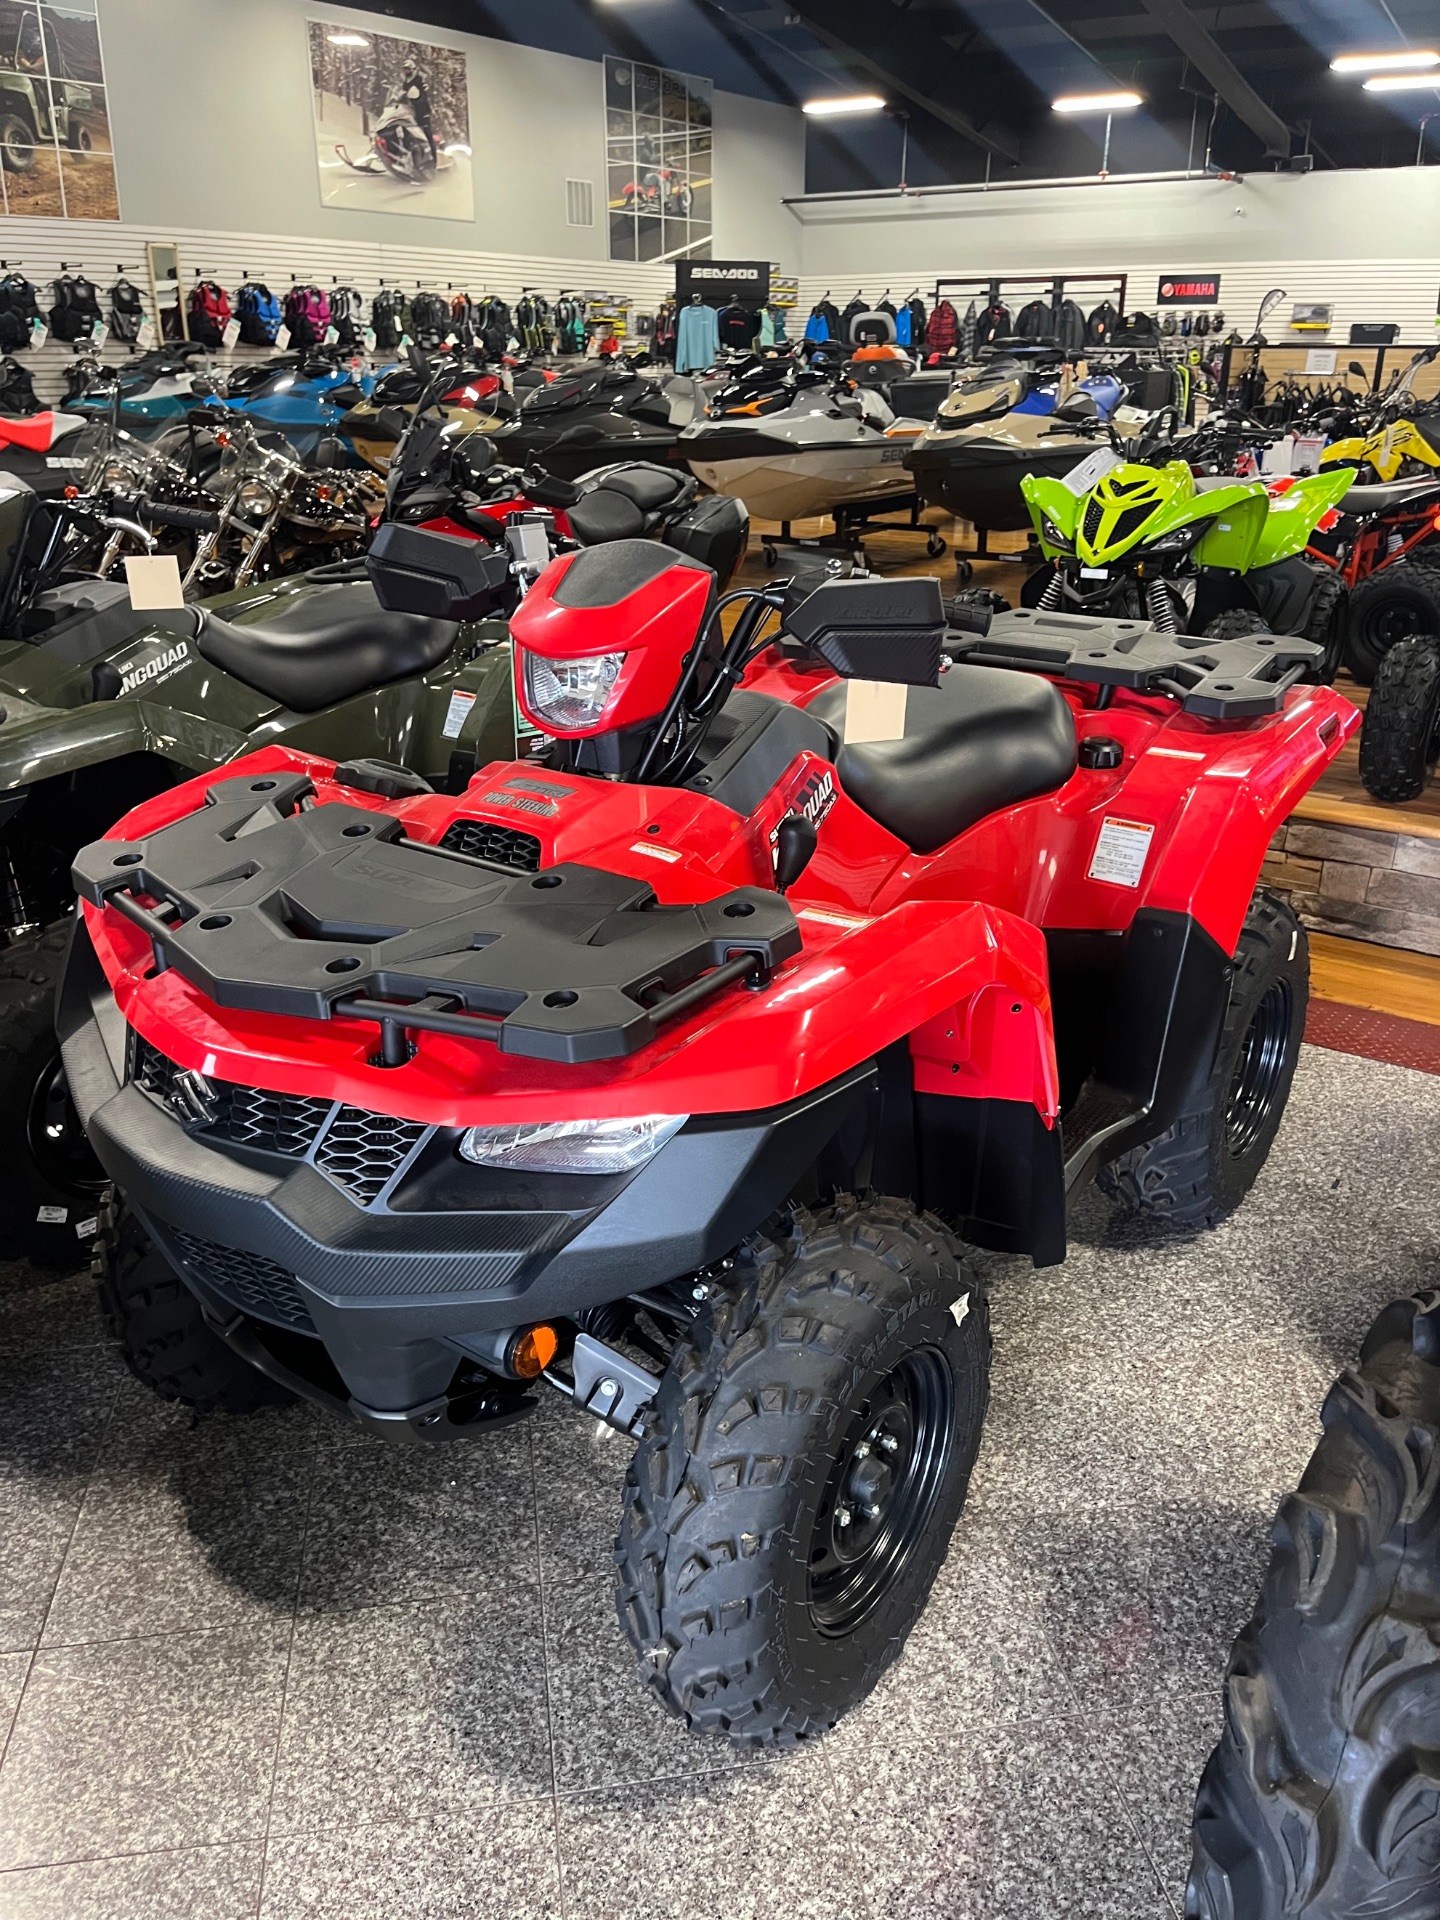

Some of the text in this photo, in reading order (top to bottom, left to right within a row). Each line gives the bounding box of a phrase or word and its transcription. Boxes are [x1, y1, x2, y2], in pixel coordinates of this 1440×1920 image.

[634, 73, 688, 96] VICOR
[1173, 282, 1215, 296] YAMAHA
[115, 641, 188, 700] NGQUAD
[481, 791, 559, 818] POWER STEERING
